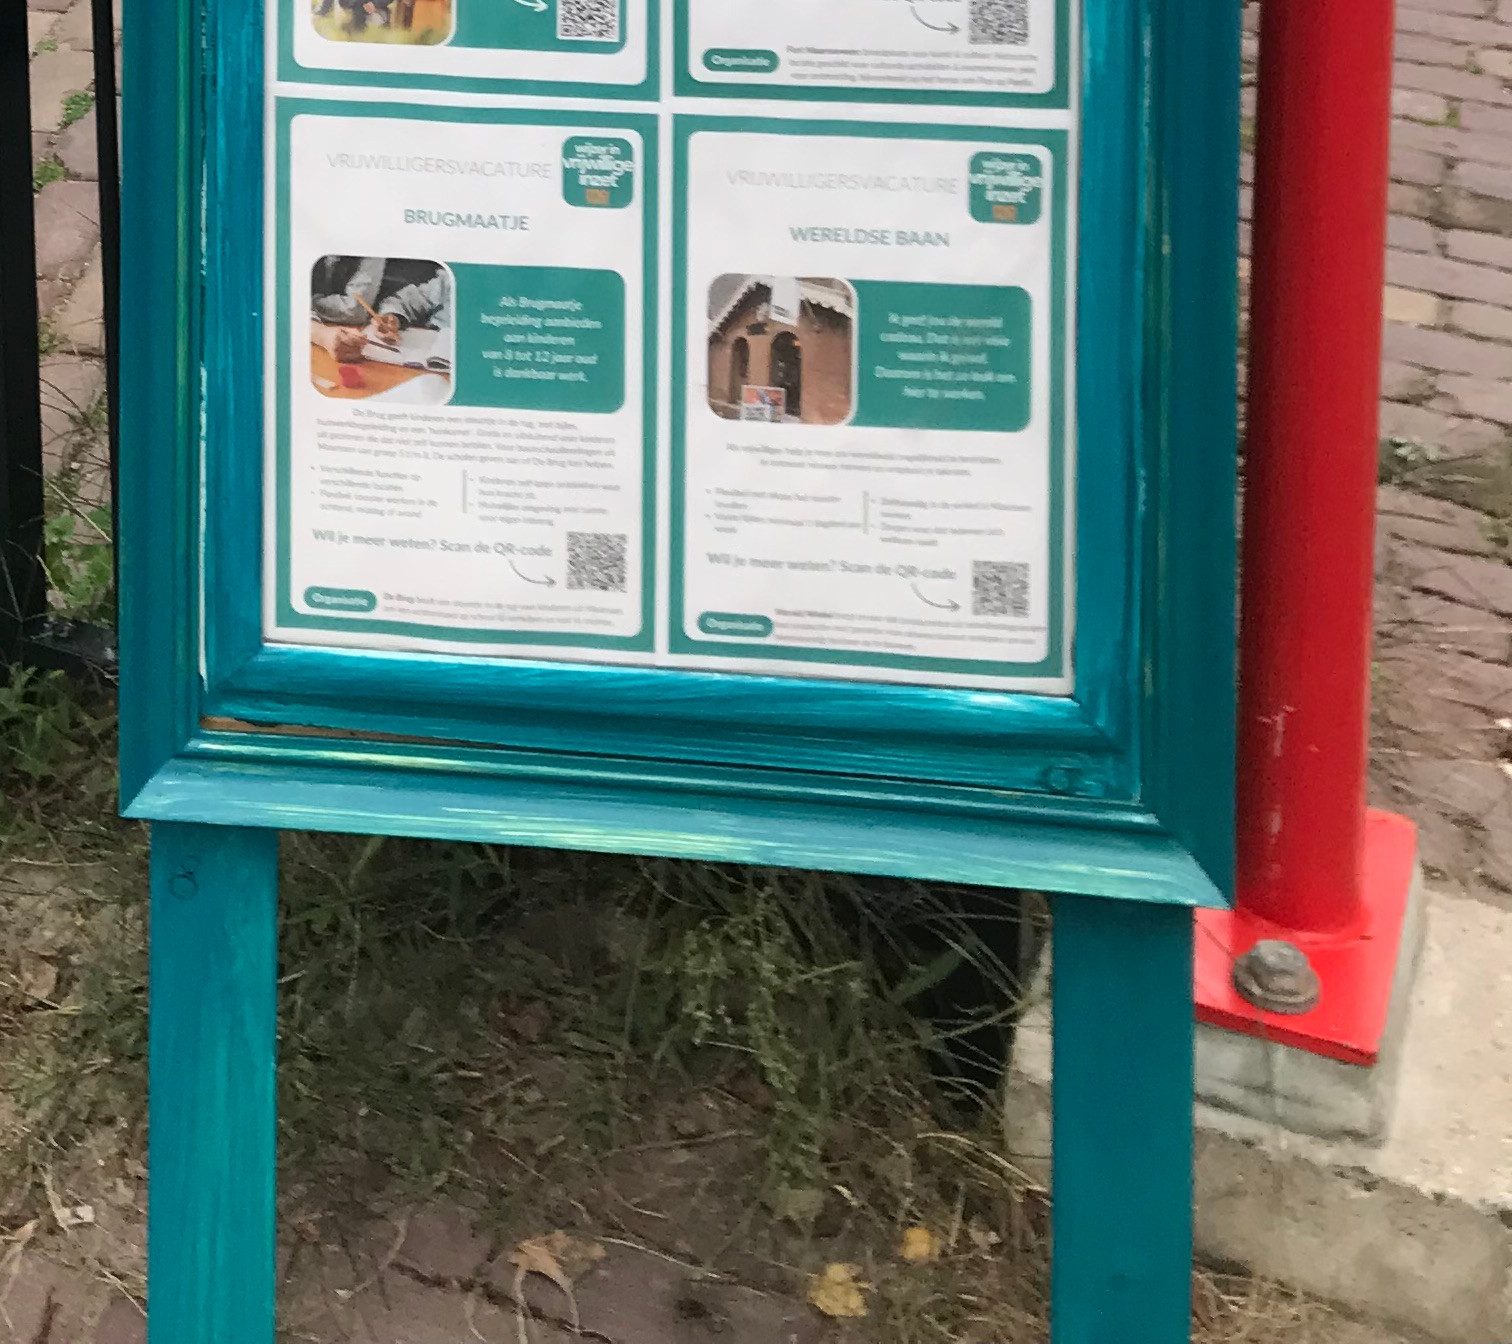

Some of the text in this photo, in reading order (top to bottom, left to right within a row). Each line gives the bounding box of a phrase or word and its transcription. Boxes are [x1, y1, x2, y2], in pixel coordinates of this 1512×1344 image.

[403, 209, 530, 231] BRUGMAATJE
[789, 227, 950, 247] WERELDSE BAAN
